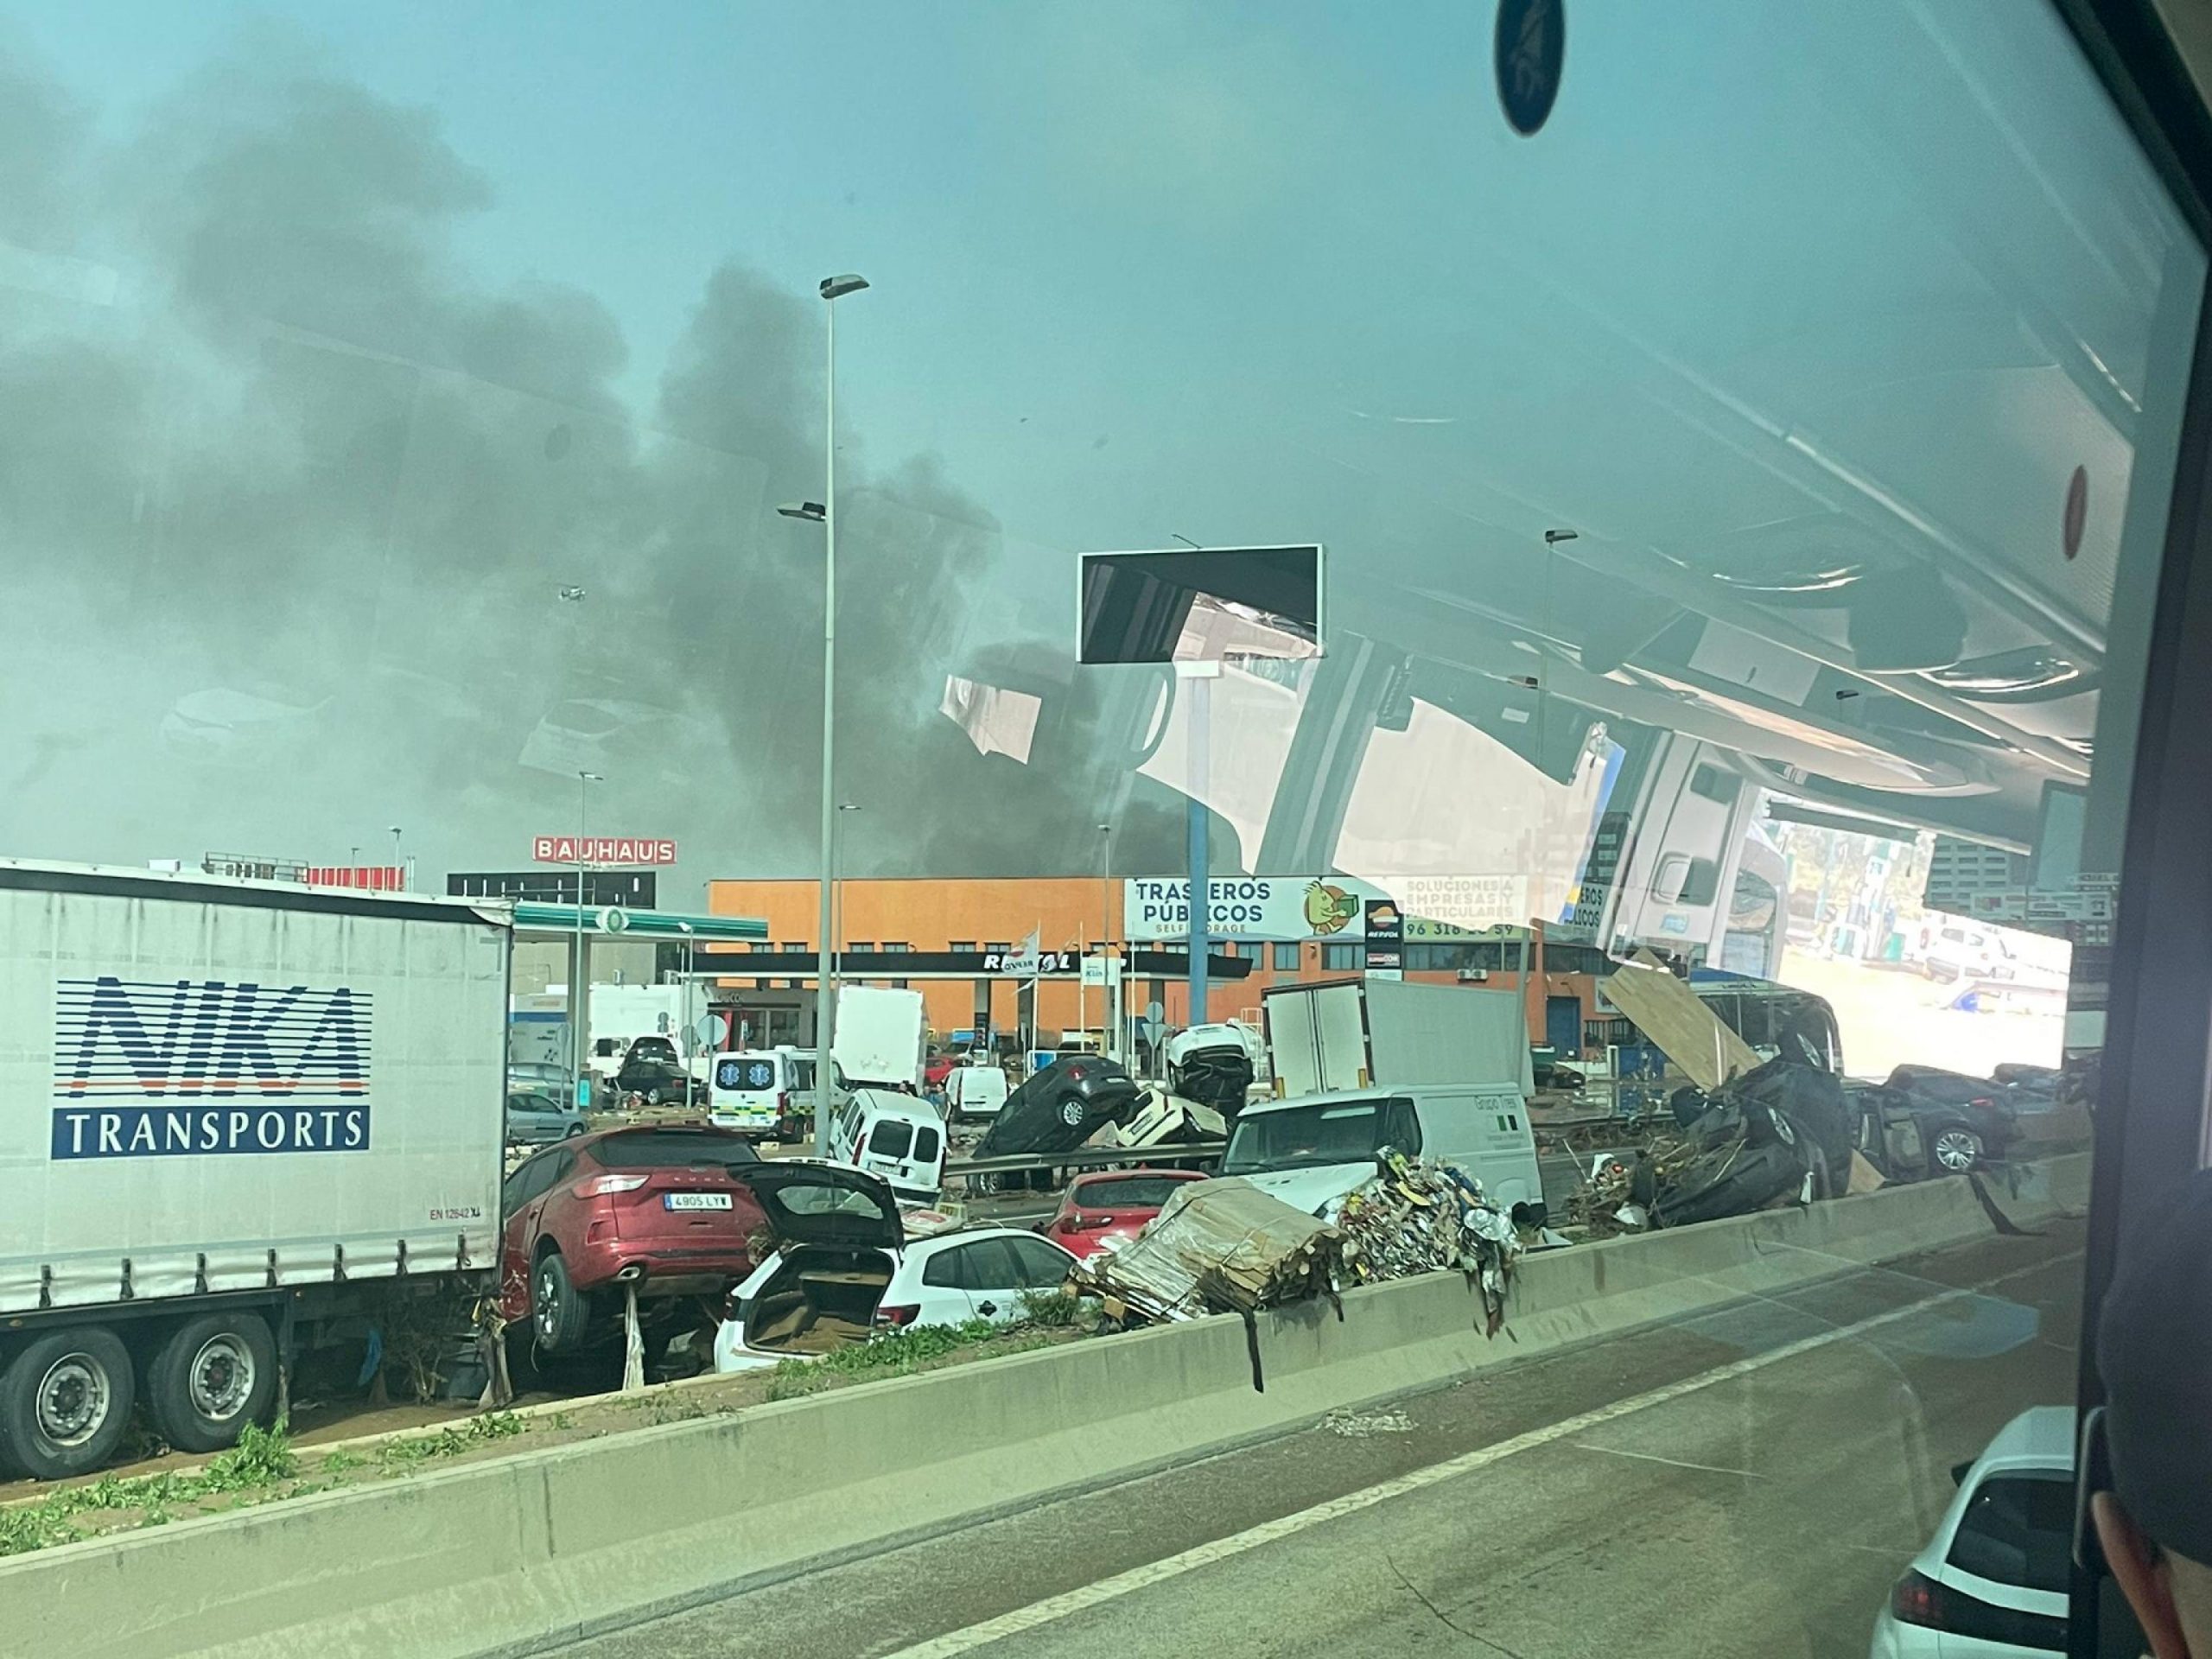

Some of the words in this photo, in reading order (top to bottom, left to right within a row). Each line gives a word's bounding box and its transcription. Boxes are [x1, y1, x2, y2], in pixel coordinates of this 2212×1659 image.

[537, 840, 672, 861] BAUHAUS
[1136, 882, 1271, 899] TRASEROS
[1407, 880, 1498, 892] SOLUCIONES
[1501, 880, 1514, 892] A
[1407, 893, 1496, 905] EMPRESAS
[1502, 893, 1513, 905] Y
[1144, 900, 1262, 922] PÚBCOS
[1156, 925, 1184, 933] SELF
[1407, 924, 1426, 936] 96
[1494, 924, 1513, 936] 59
[68, 977, 364, 1097] NIKA
[65, 1110, 362, 1153] TRANSPORTS
[430, 1209, 442, 1220] EN
